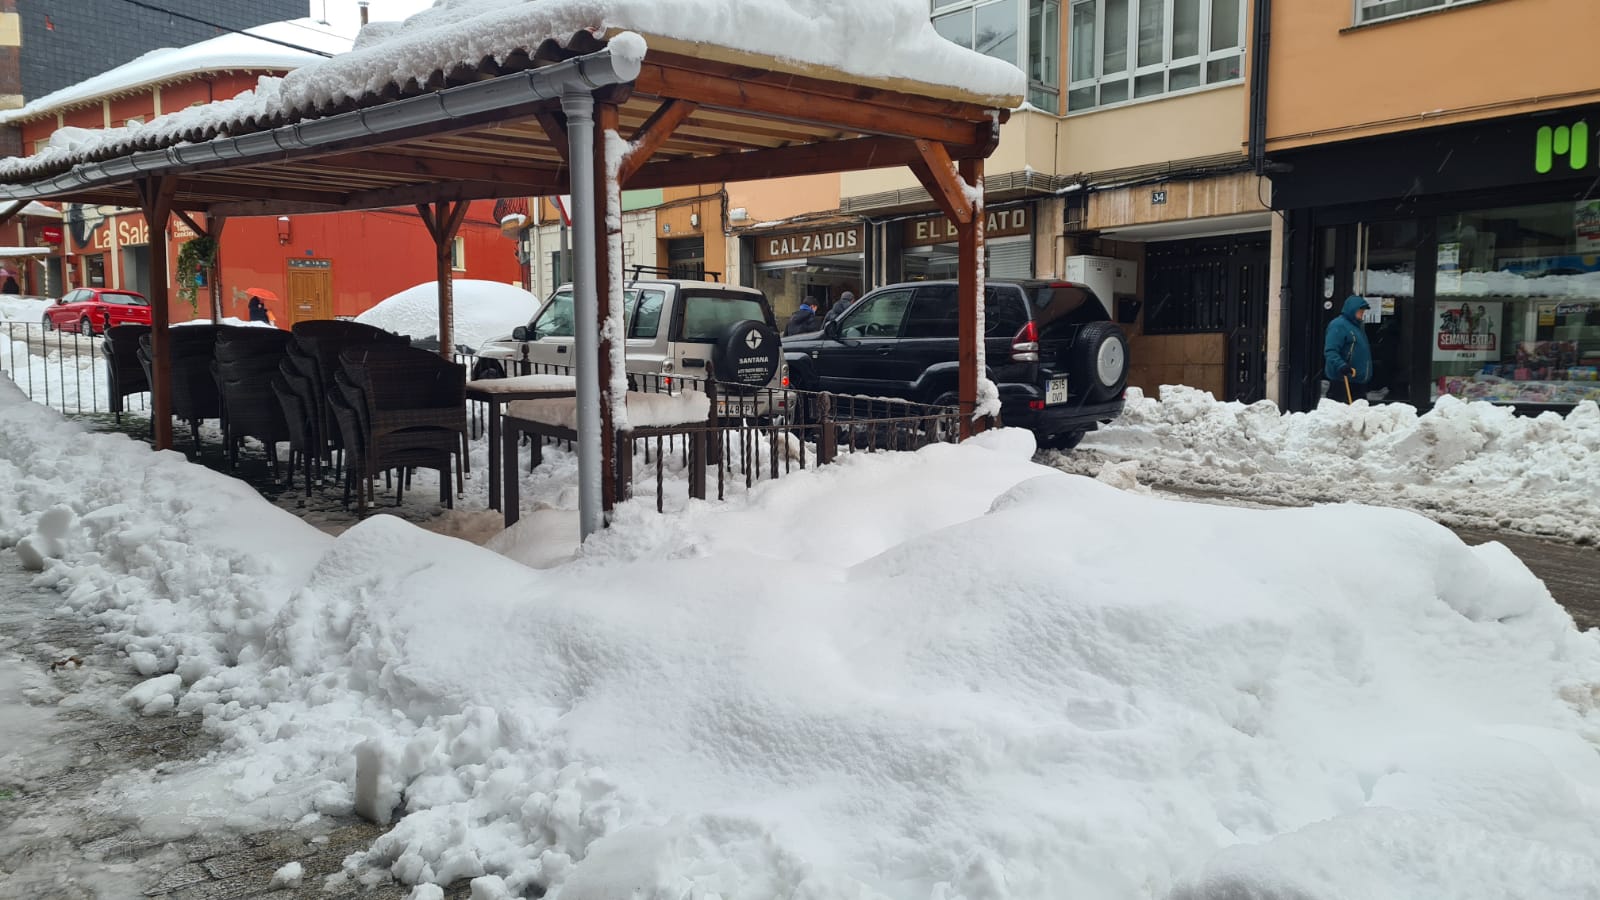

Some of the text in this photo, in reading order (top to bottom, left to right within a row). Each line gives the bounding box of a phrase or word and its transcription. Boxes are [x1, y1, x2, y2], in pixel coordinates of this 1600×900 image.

[1153, 193, 1164, 202] 34
[94, 218, 150, 249] La Sala
[916, 209, 1025, 240] EL BATO
[770, 229, 857, 256] CALZADOS
[1440, 333, 1495, 345] SEMANA EXTRA
[739, 356, 768, 364] SANTANA
